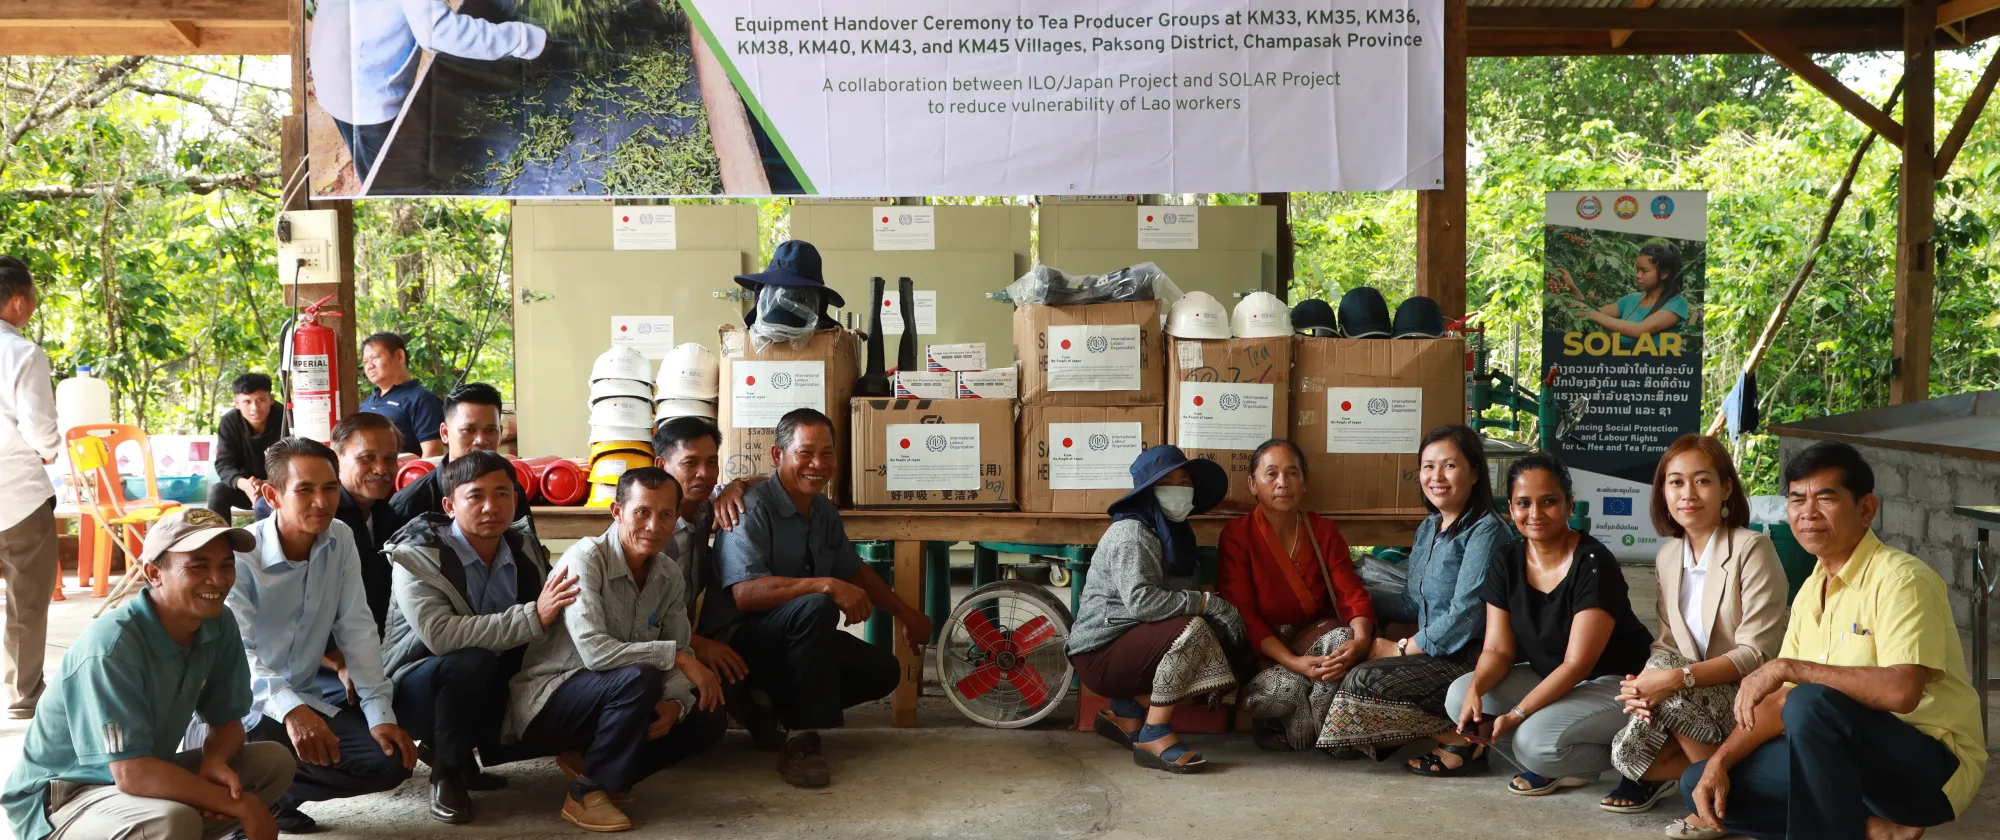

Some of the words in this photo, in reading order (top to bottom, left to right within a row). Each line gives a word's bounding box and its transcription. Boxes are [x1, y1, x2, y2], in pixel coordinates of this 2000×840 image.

[735, 16, 829, 34] Equipment
[834, 16, 918, 31] Handover
[923, 15, 1011, 33] Ceremony
[1017, 15, 1034, 30] to
[1038, 15, 1068, 29] Tea
[1074, 14, 1153, 29] Producer
[1158, 13, 1219, 28] Groups
[1225, 11, 1242, 26] at
[1247, 10, 1302, 27] KM33,
[1306, 9, 1361, 27] KM35,
[1366, 8, 1421, 25] KM36,
[738, 40, 794, 57] KM38,
[799, 40, 856, 56] KM40,
[861, 39, 917, 56] KM43,
[922, 39, 953, 54] and
[959, 38, 1010, 53] KM45
[1014, 38, 1087, 55] Villages,
[1092, 37, 1165, 54] Paksong
[1171, 34, 1239, 52] District,
[1243, 33, 1342, 51] Champasak
[1347, 32, 1423, 48] Province
[822, 78, 834, 92] A
[838, 78, 947, 92] collaboration
[953, 77, 1023, 91] between
[1028, 75, 1113, 92] ILO/Japan
[1119, 73, 1178, 92] Project
[1183, 73, 1213, 87] and
[1218, 72, 1277, 87] SOLAR
[1282, 71, 1341, 90] Project
[928, 100, 945, 114] to
[950, 99, 1007, 113] reduce
[1012, 97, 1115, 114] vulnerability
[1120, 96, 1136, 110] of
[1141, 96, 1171, 110] Lao
[1176, 96, 1241, 110] workers
[1563, 331, 1682, 356] SOLAR
[1244, 345, 1271, 368] Tea
[1621, 379, 1640, 388] ແລະ
[1635, 406, 1655, 415] ແລະ
[1659, 407, 1671, 417] ຊາ
[1574, 424, 1602, 433] ancing
[1634, 425, 1678, 433] Protection
[1631, 434, 1658, 443] Rights
[1562, 442, 1574, 450] for
[1576, 443, 1605, 451] Cffee
[1642, 444, 1668, 452] Farme
[1231, 464, 1251, 473] 8.5k
